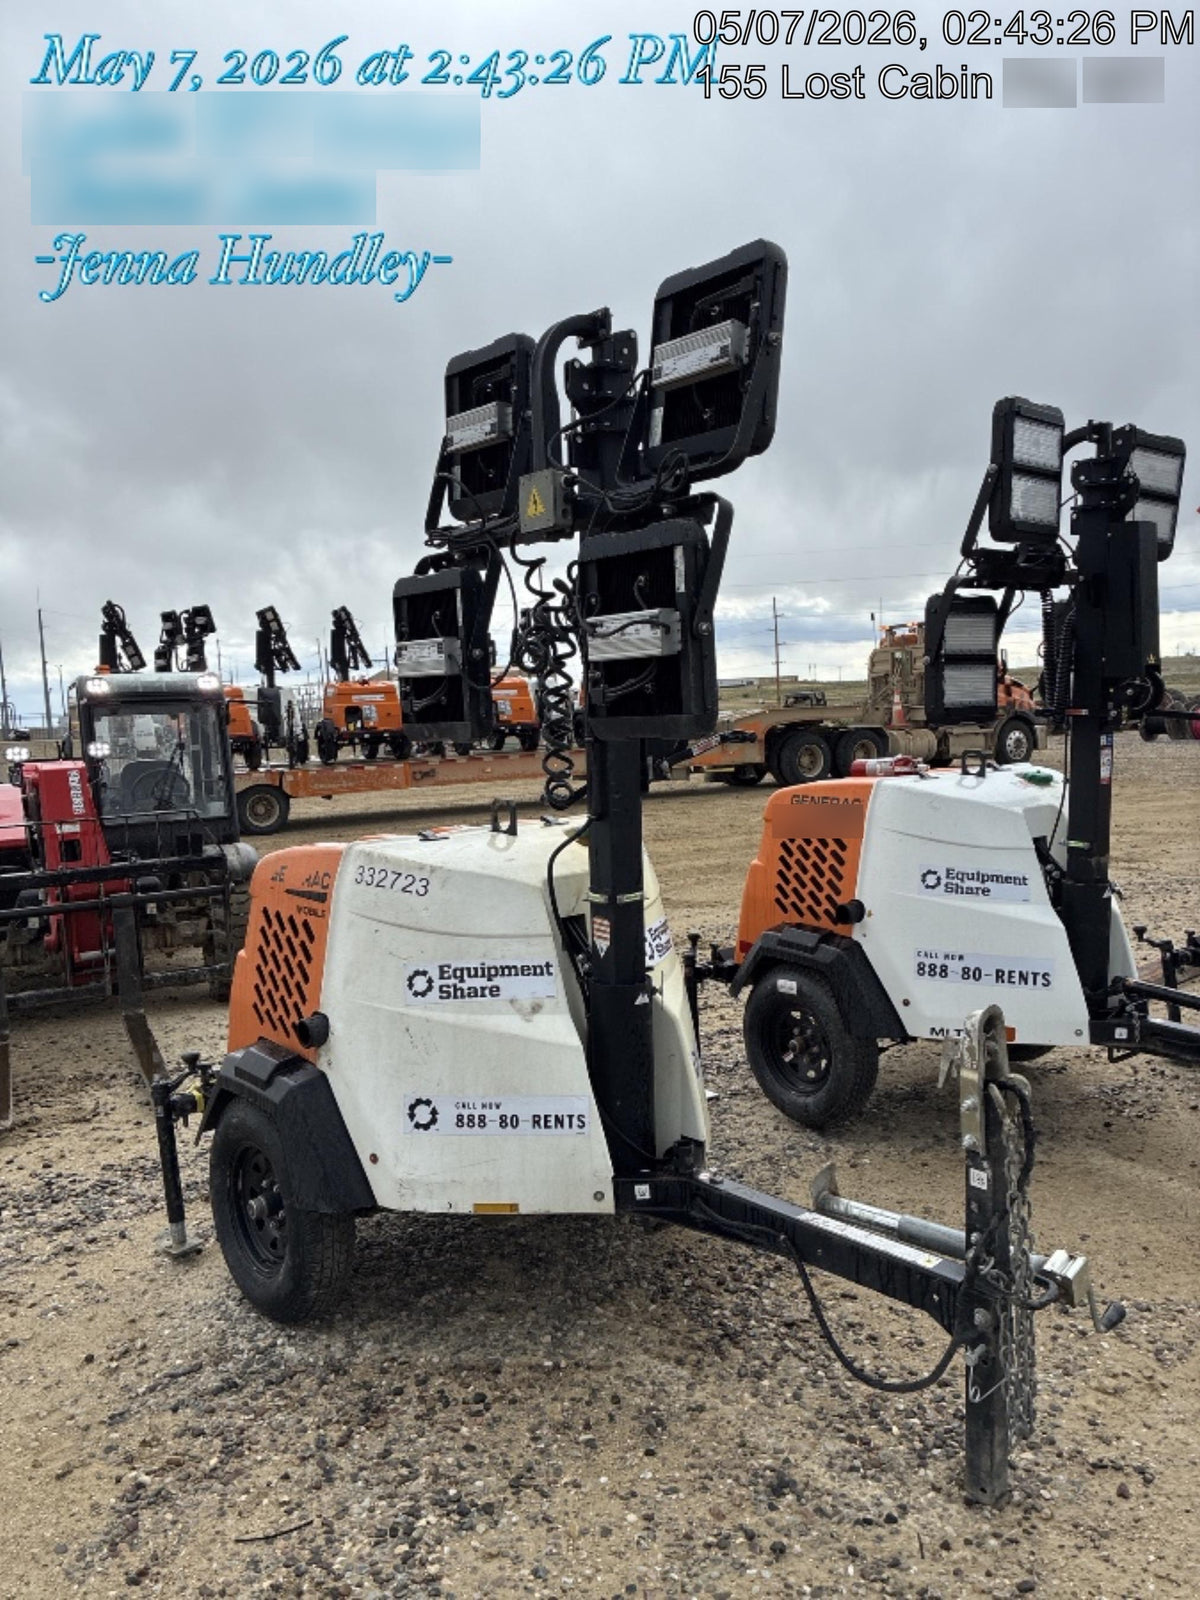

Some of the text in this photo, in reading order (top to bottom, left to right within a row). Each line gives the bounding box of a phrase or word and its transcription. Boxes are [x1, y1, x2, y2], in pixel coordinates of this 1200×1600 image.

[354, 865, 430, 897] 332723
[945, 867, 1029, 886] Equipment
[944, 881, 991, 896] Share
[917, 950, 939, 959] CALL
[438, 961, 553, 983] Equipment
[916, 961, 1052, 988] 888-80-RENTS
[438, 983, 500, 1000] Share
[454, 1101, 502, 1110] CALL NOW
[455, 1113, 586, 1130] 888-80-RENTS
